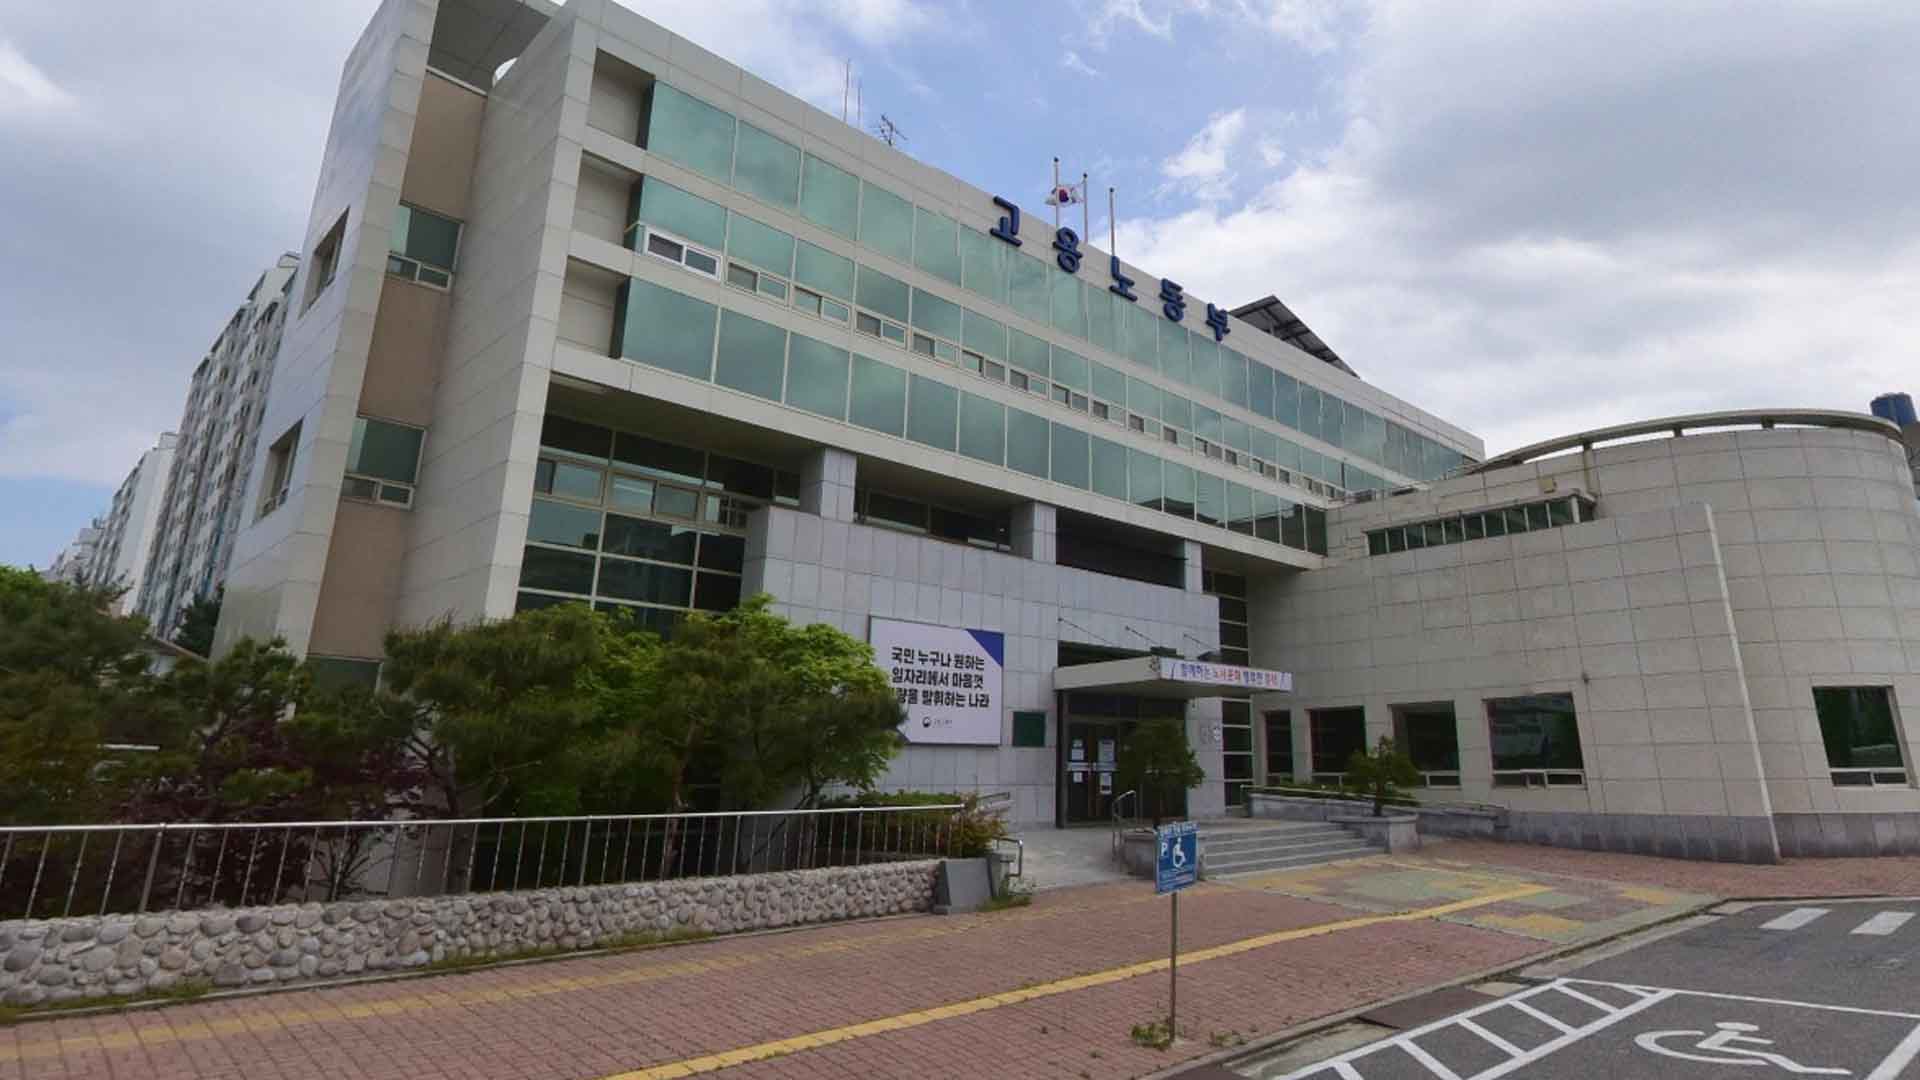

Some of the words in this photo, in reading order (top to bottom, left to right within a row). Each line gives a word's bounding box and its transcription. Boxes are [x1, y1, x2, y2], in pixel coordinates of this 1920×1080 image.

[990, 195, 1230, 341] 고용노동부
[892, 647, 914, 665] 국민
[919, 649, 951, 668] 누구나
[954, 652, 985, 671] 원하는
[892, 666, 949, 687] 일자리에서
[952, 671, 984, 689] 마음껏
[891, 687, 918, 705] 량을
[922, 689, 966, 708] 발휘하는
[968, 692, 990, 708] 나라
[1160, 842, 1168, 857] P
